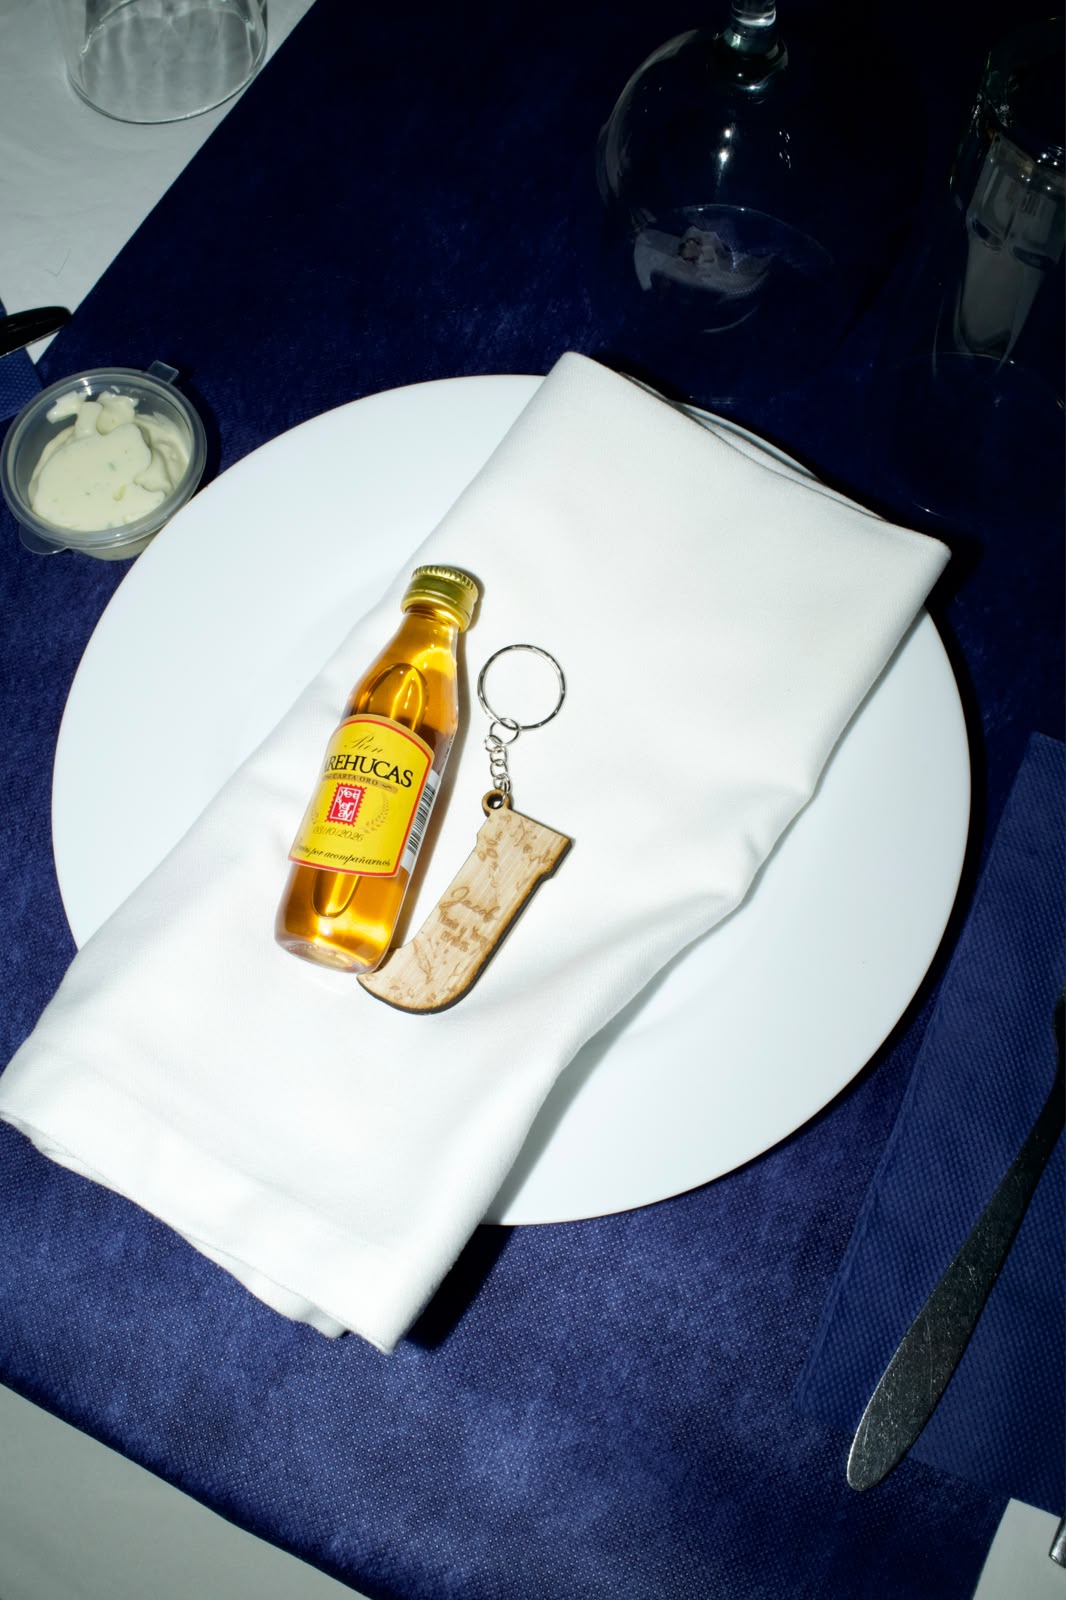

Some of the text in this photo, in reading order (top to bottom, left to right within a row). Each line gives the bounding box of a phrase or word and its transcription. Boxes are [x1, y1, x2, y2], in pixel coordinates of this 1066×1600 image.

[332, 773, 379, 786] CARTA ORO
[324, 851, 391, 867] acompañarnos
